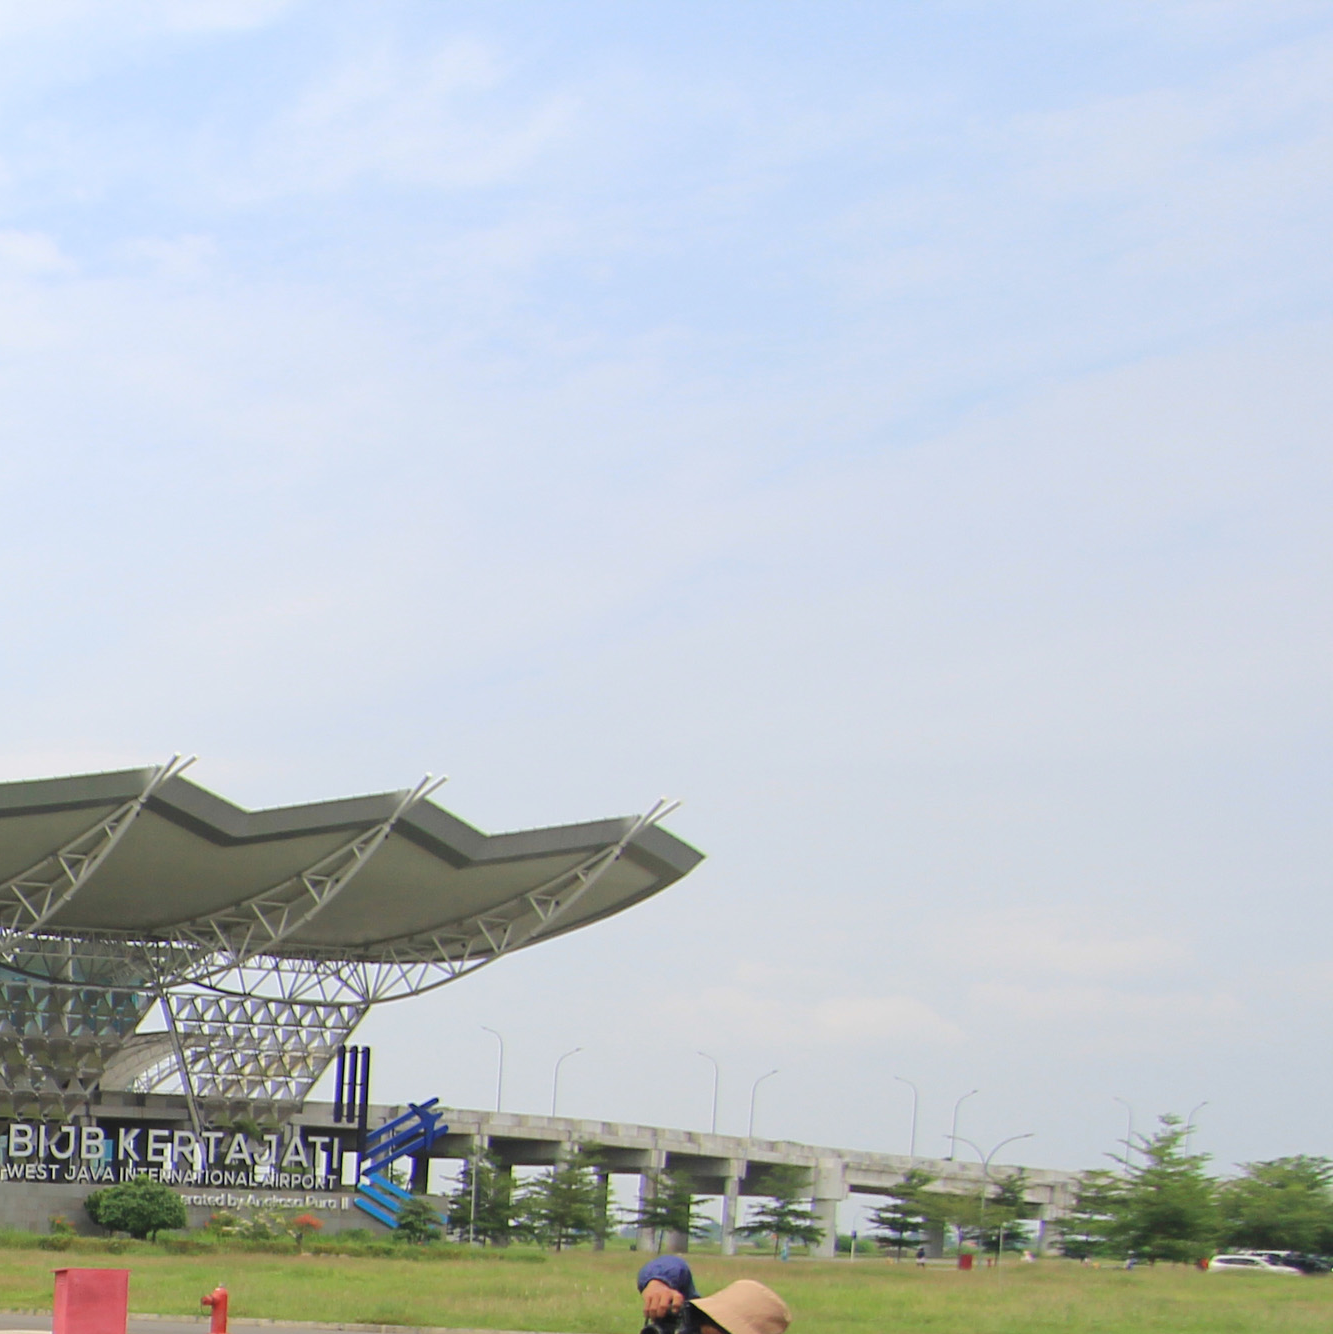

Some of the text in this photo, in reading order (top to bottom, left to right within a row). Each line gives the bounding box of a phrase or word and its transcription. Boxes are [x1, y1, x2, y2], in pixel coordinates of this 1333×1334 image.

[8, 1123, 339, 1169] BIJB KERTAJATI
[7, 1163, 337, 1190] WEST JAVA INTERNATIONAL AIRPORT
